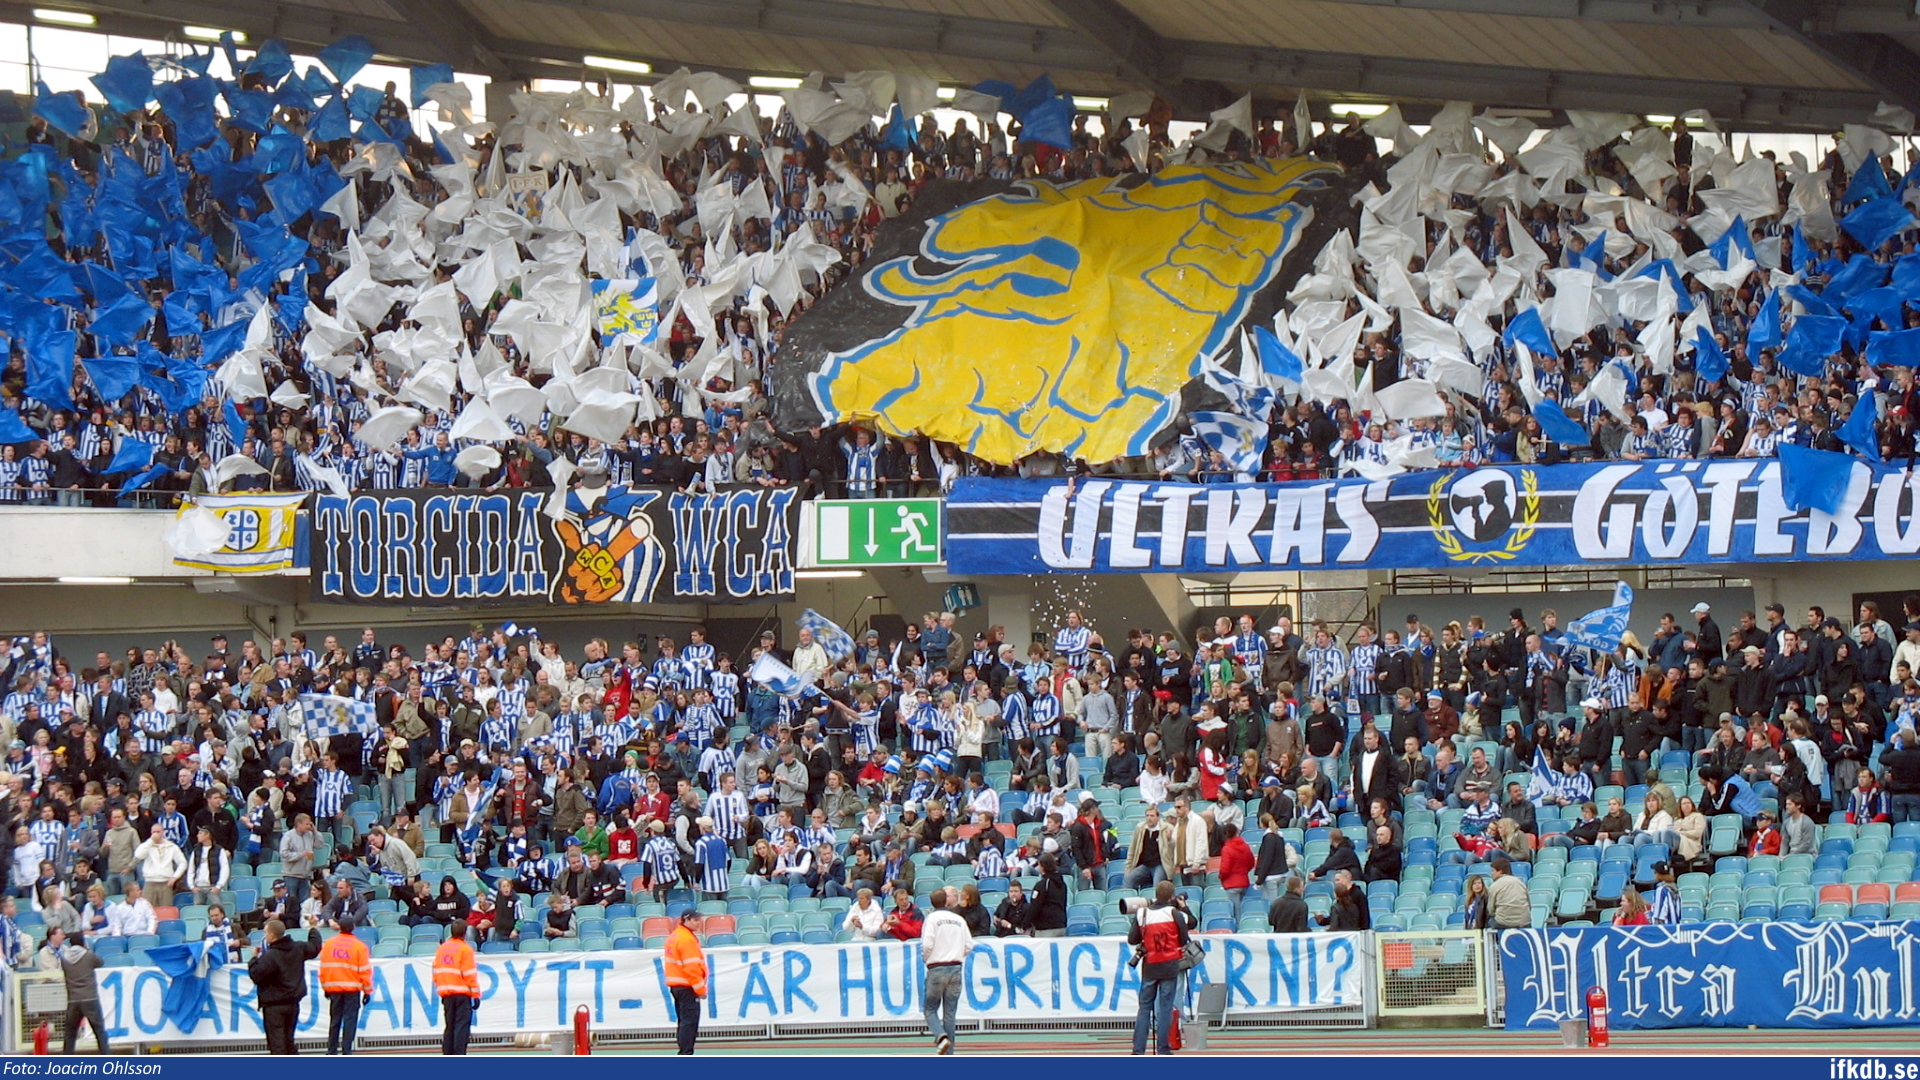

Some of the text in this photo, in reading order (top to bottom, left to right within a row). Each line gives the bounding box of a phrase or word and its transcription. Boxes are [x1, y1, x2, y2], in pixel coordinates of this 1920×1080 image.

[315, 486, 798, 598] TORCIDA WCA
[1038, 479, 1397, 568] ULTRAS
[662, 854, 673, 870] 9
[101, 970, 169, 1038] 10
[739, 950, 819, 1018] ÄR
[333, 948, 350, 959] ICA
[441, 954, 455, 965] ICA
[1500, 927, 1736, 1026] Ultra
